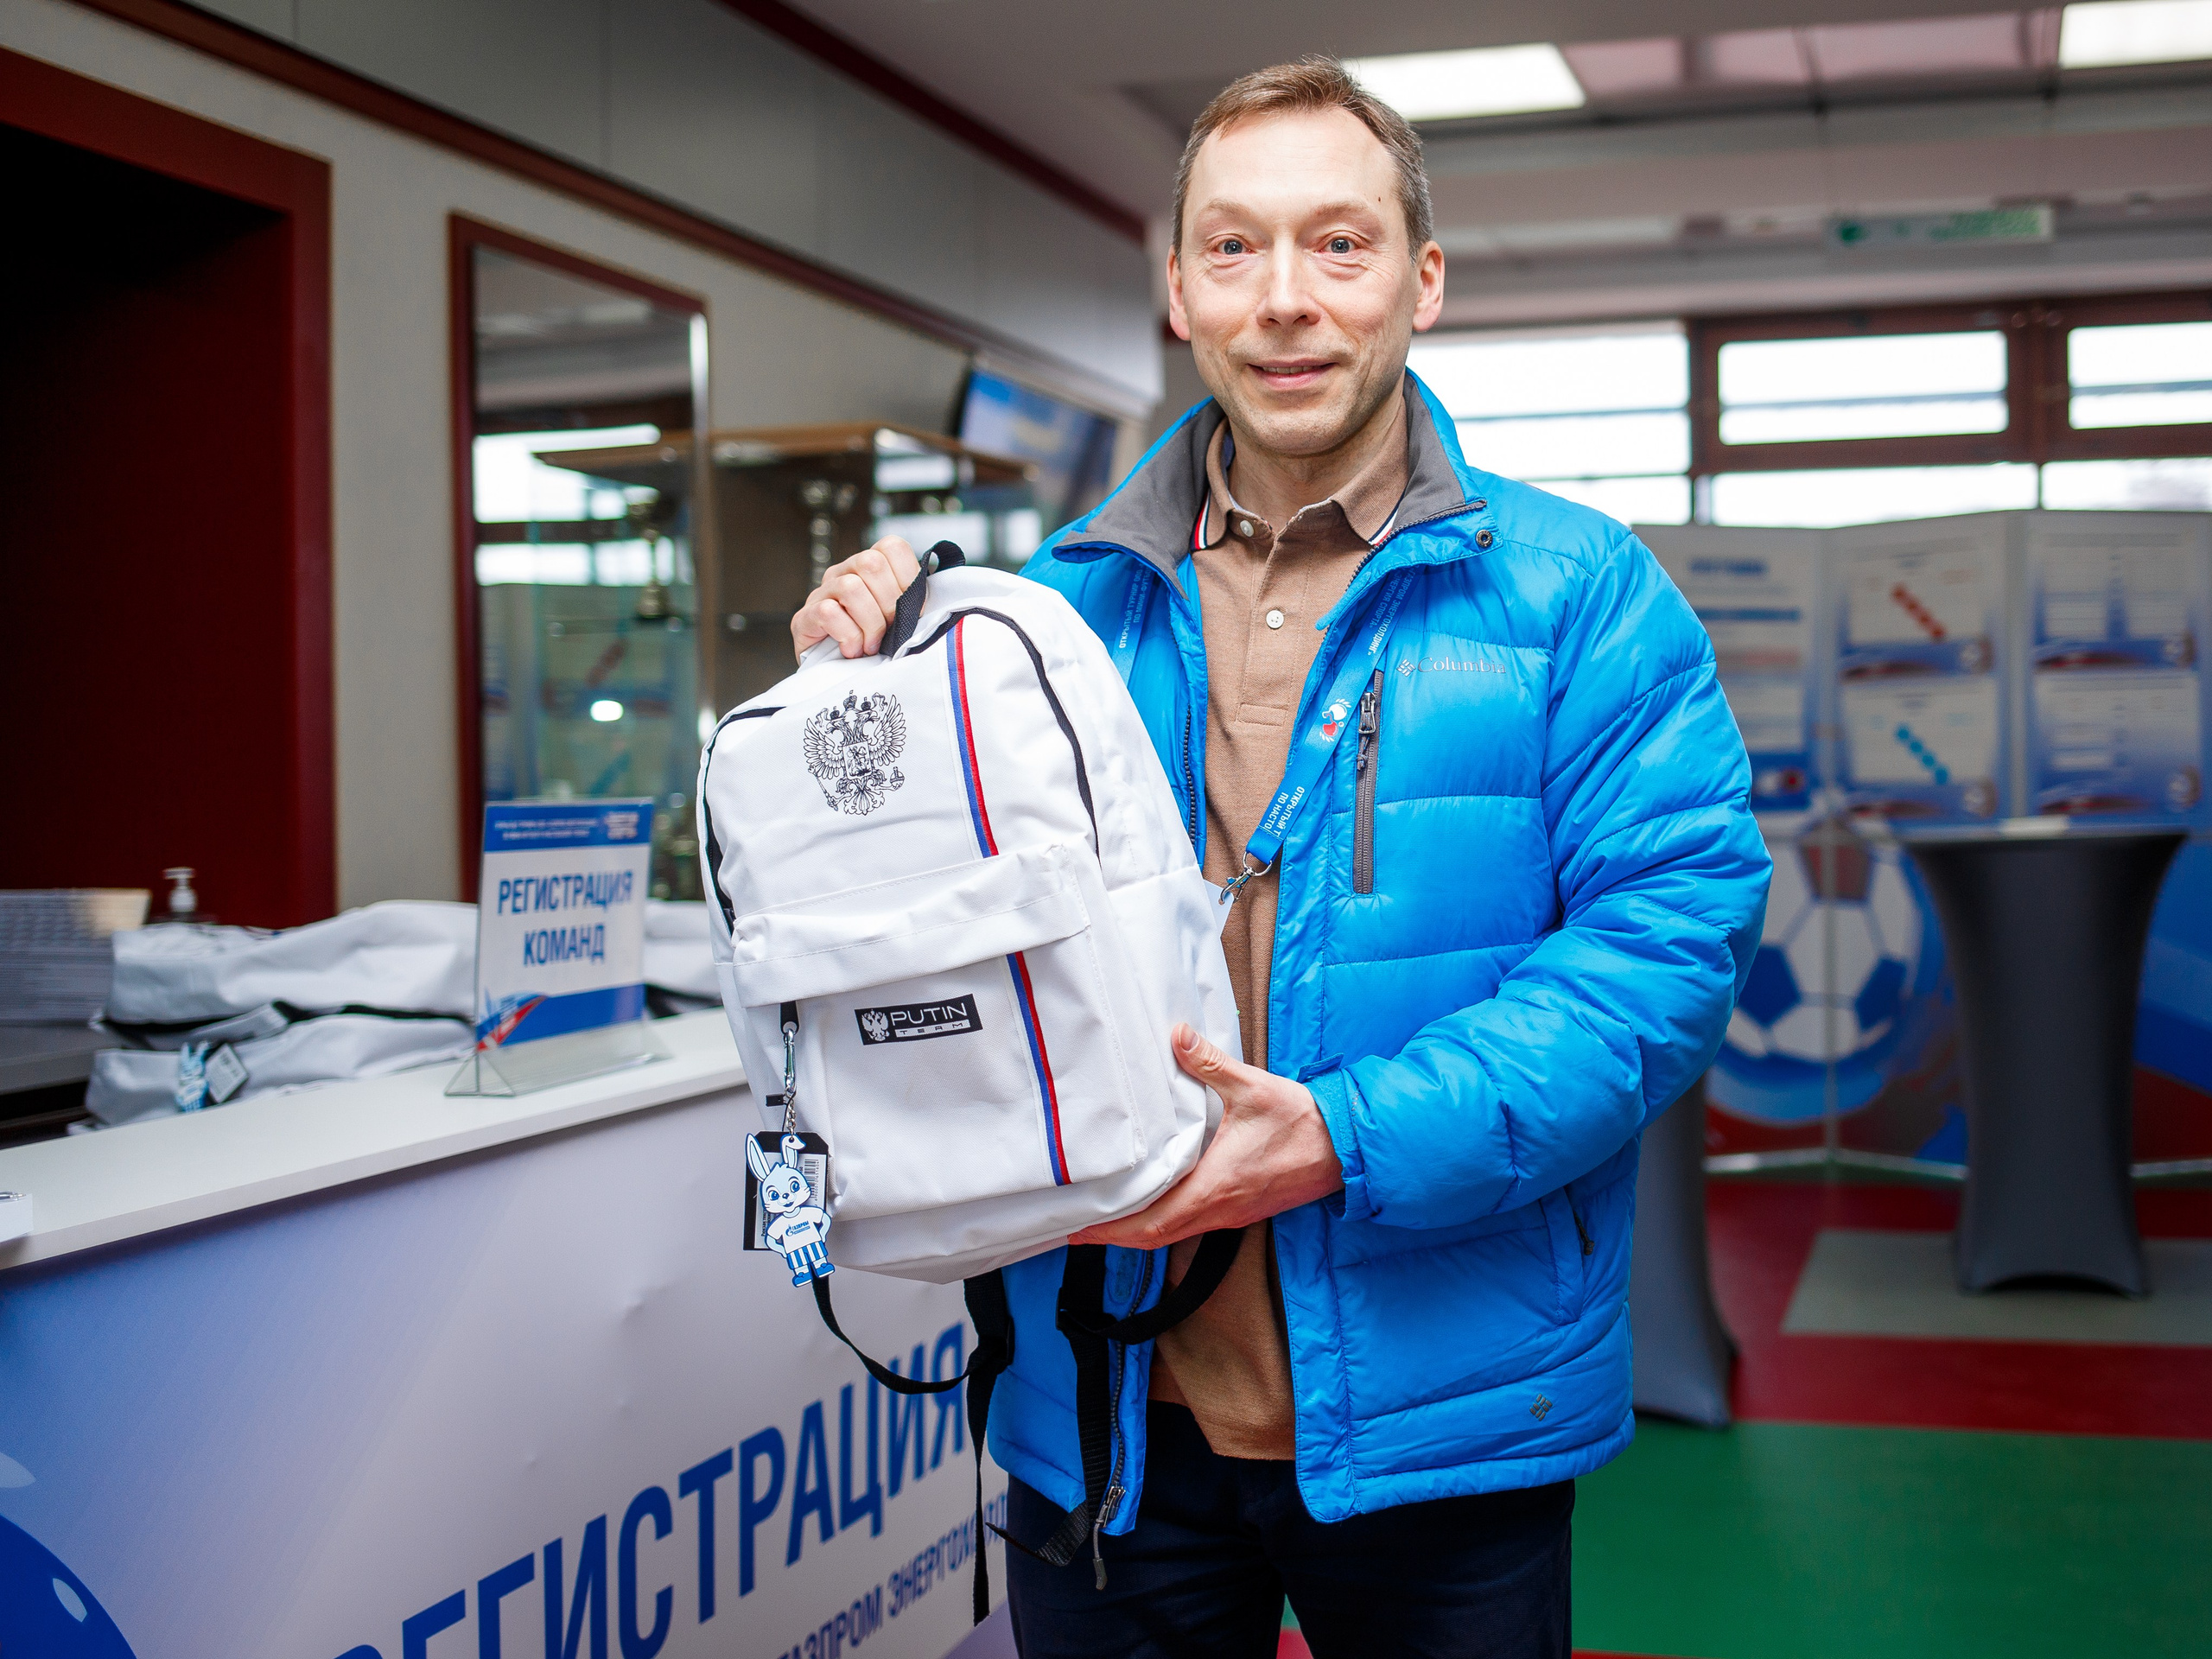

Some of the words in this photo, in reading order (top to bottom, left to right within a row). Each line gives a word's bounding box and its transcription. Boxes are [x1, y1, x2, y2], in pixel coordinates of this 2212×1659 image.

[1119, 610, 1133, 648] ОТКРЫТЫЙ
[1418, 656, 1506, 674] Columbia
[1276, 785, 1305, 830] ОТКРЫТЫЙ
[1277, 791, 1289, 804] ПО
[497, 869, 633, 915] РЕГИСТРАЦИЯ
[523, 924, 606, 967] КОМАНД
[890, 1002, 968, 1027] PUTIN
[899, 1022, 963, 1035] TEAM
[334, 1320, 964, 1659] ГИСТРАЦИЯ
[777, 1584, 882, 1659] ЗПРОМ
